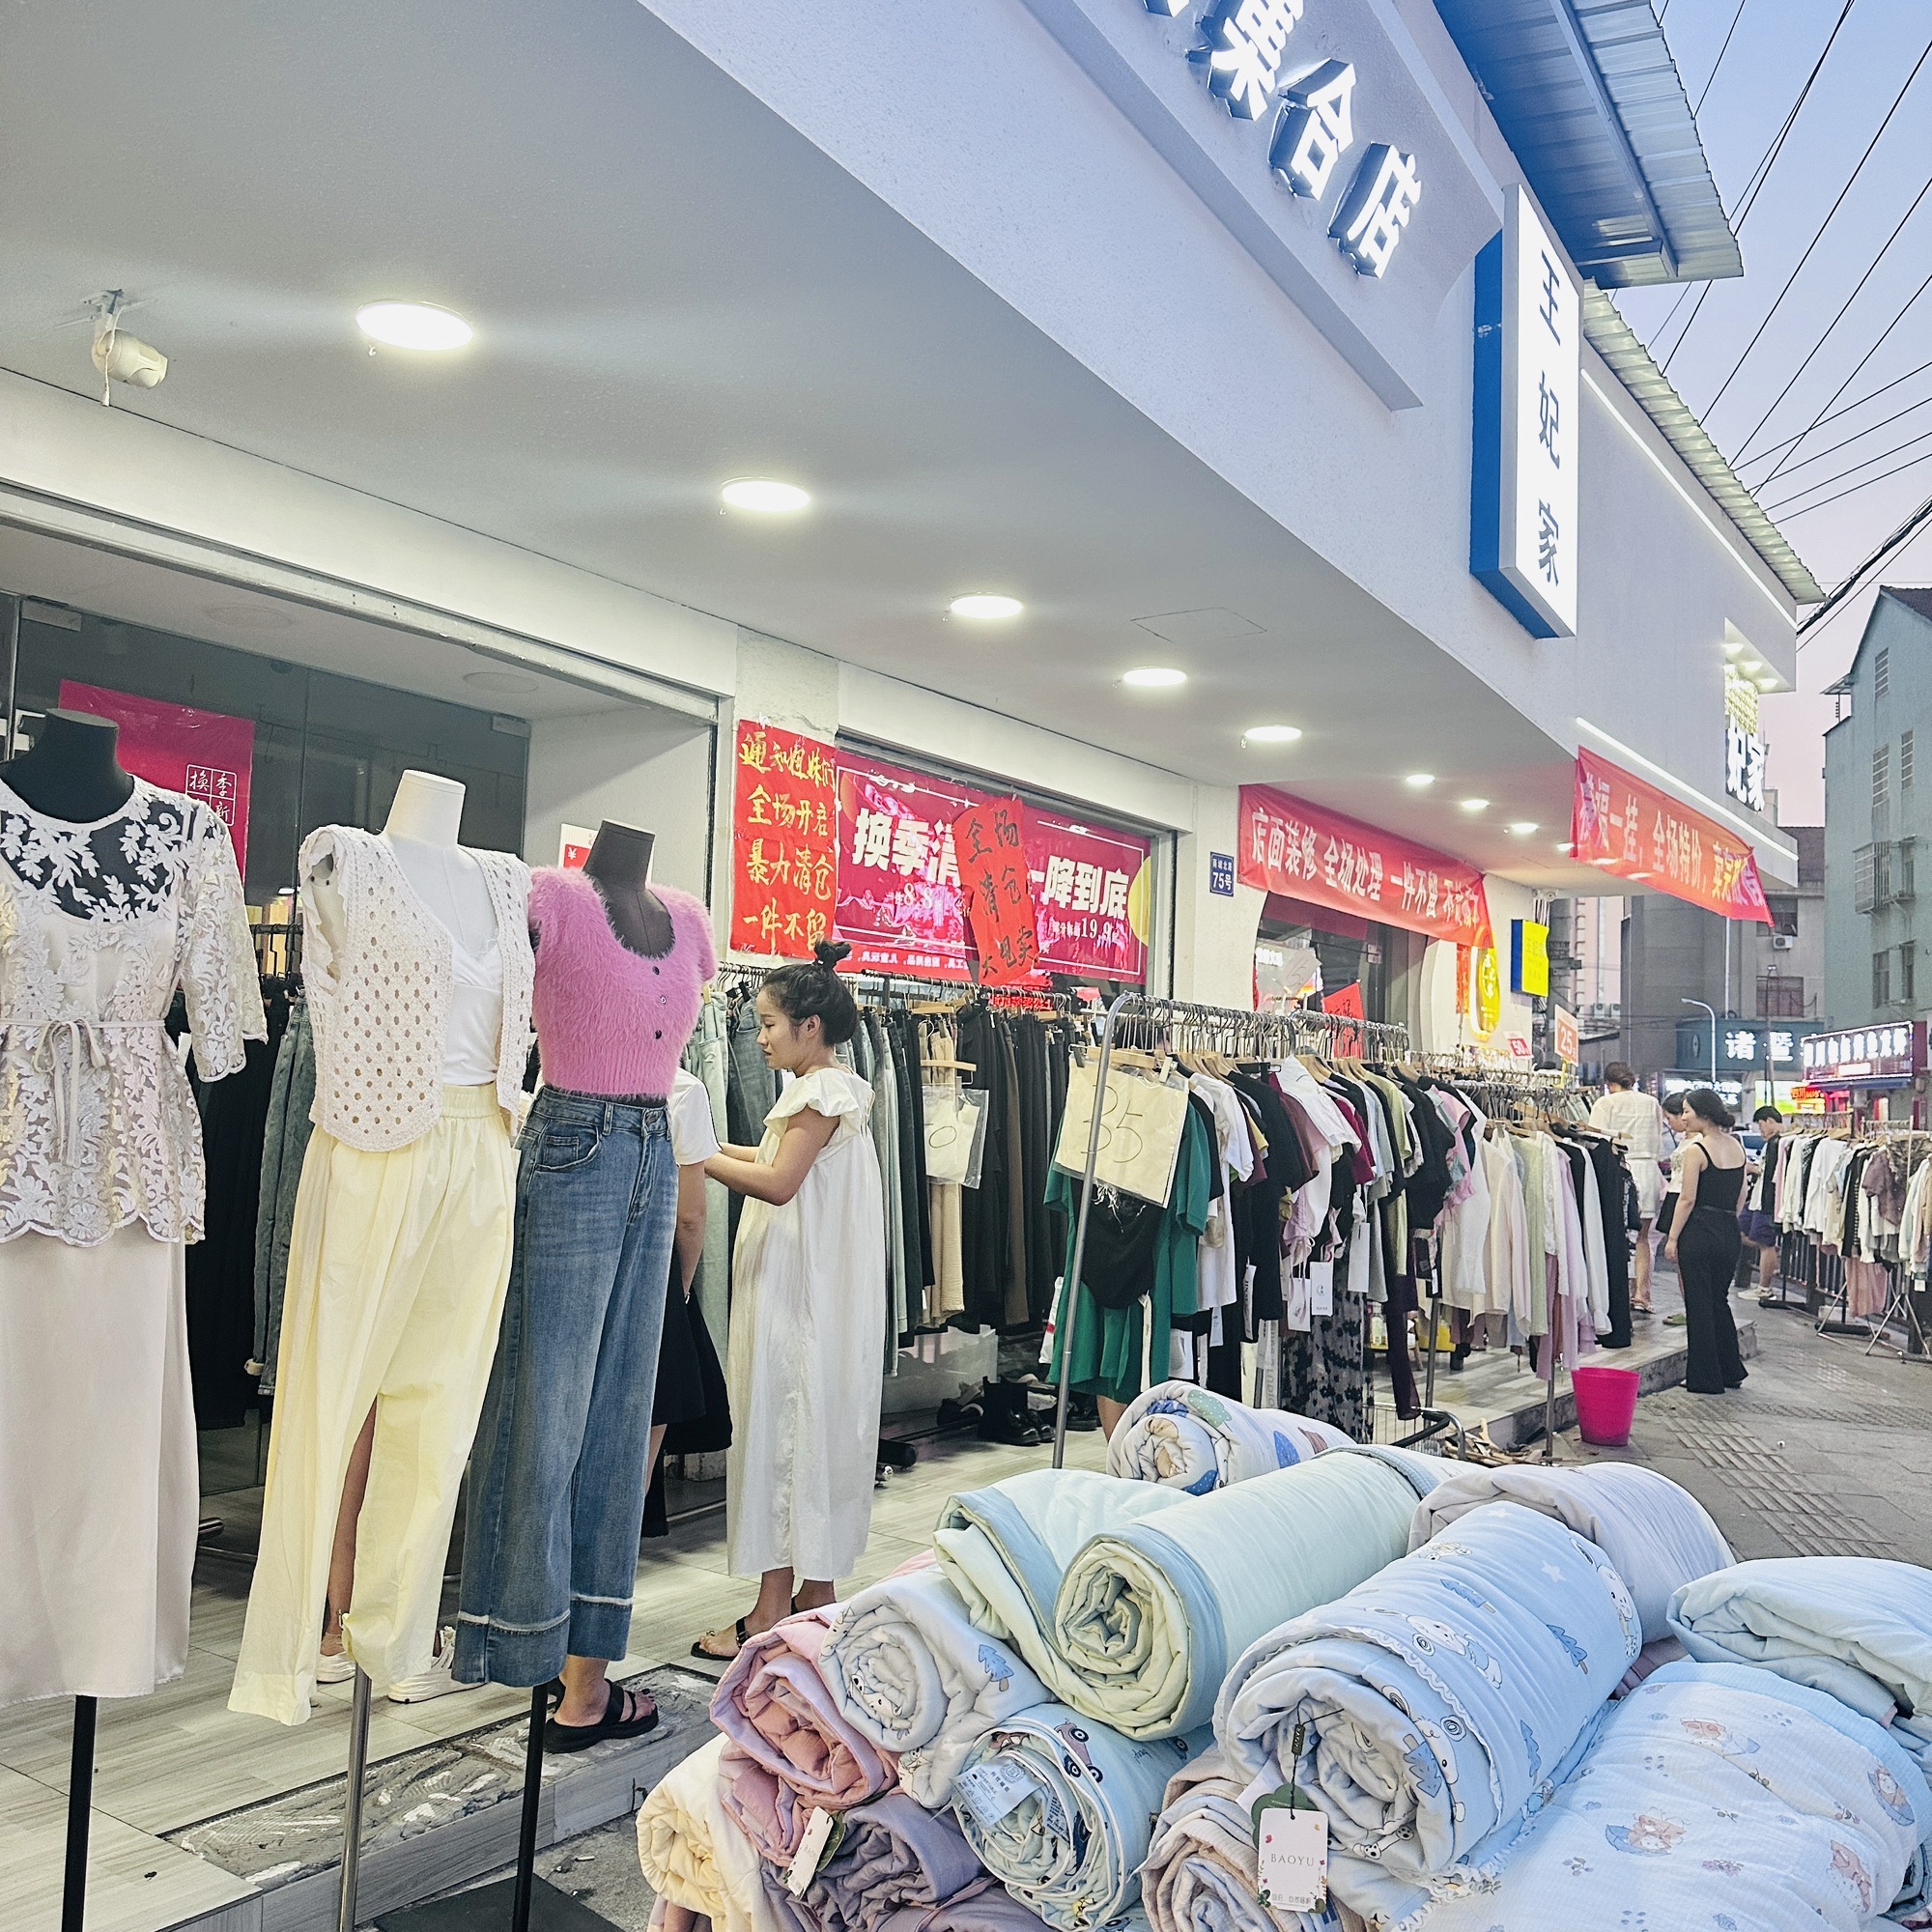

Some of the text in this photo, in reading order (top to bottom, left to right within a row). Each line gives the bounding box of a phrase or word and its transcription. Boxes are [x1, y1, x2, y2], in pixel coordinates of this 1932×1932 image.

[1538, 248, 1561, 587] 王妃家
[966, 809, 1019, 864] 全场
[1251, 807, 1318, 881] 店面装修
[1323, 835, 1384, 902] 全场处理
[1391, 861, 1438, 919] 一件不留
[746, 838, 834, 900] 暴力清仓
[979, 865, 1022, 923] 清仓
[1212, 871, 1233, 891] 75号
[742, 896, 828, 952] 一件不留
[1270, 1854, 1315, 1866] BAOYU
